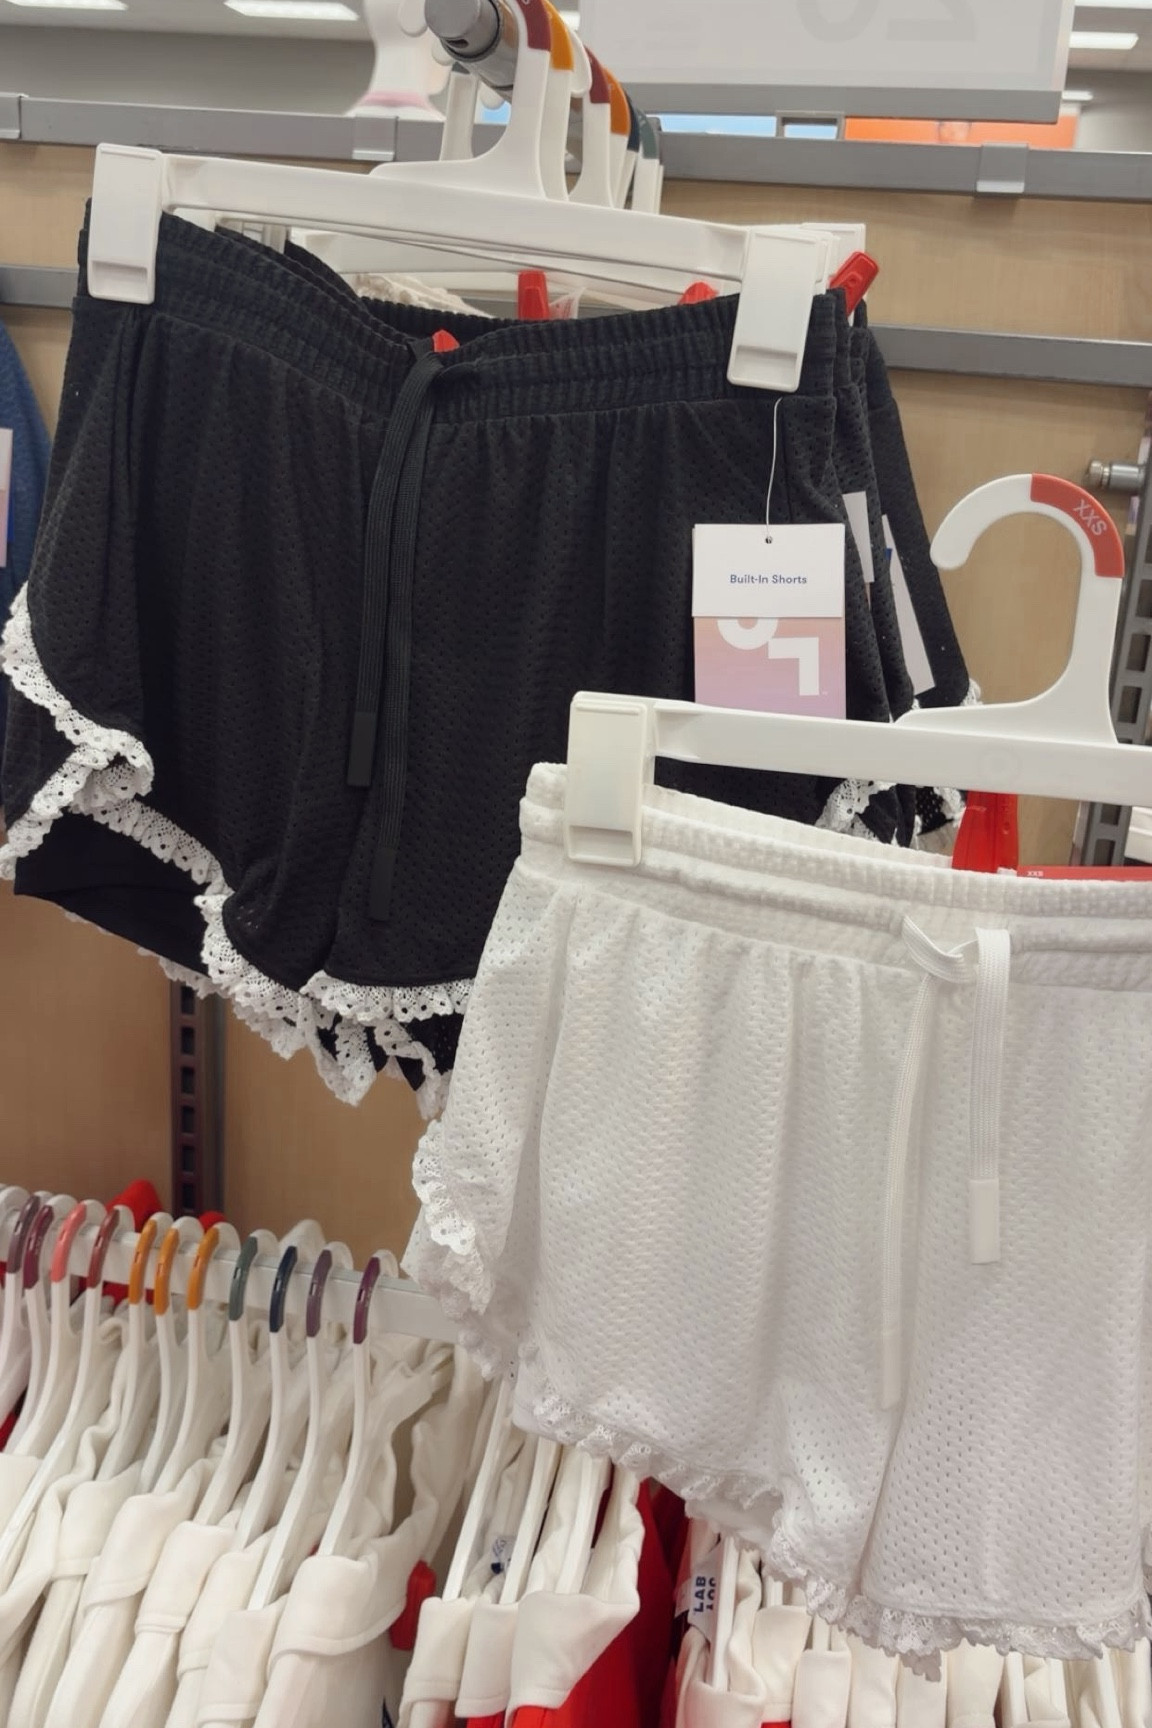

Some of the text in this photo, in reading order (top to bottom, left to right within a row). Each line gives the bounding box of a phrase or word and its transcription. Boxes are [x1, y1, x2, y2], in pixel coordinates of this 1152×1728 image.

[1072, 499, 1107, 536] XXS
[730, 574, 808, 584] Built-In Shorts
[694, 1576, 706, 1613] LAB
